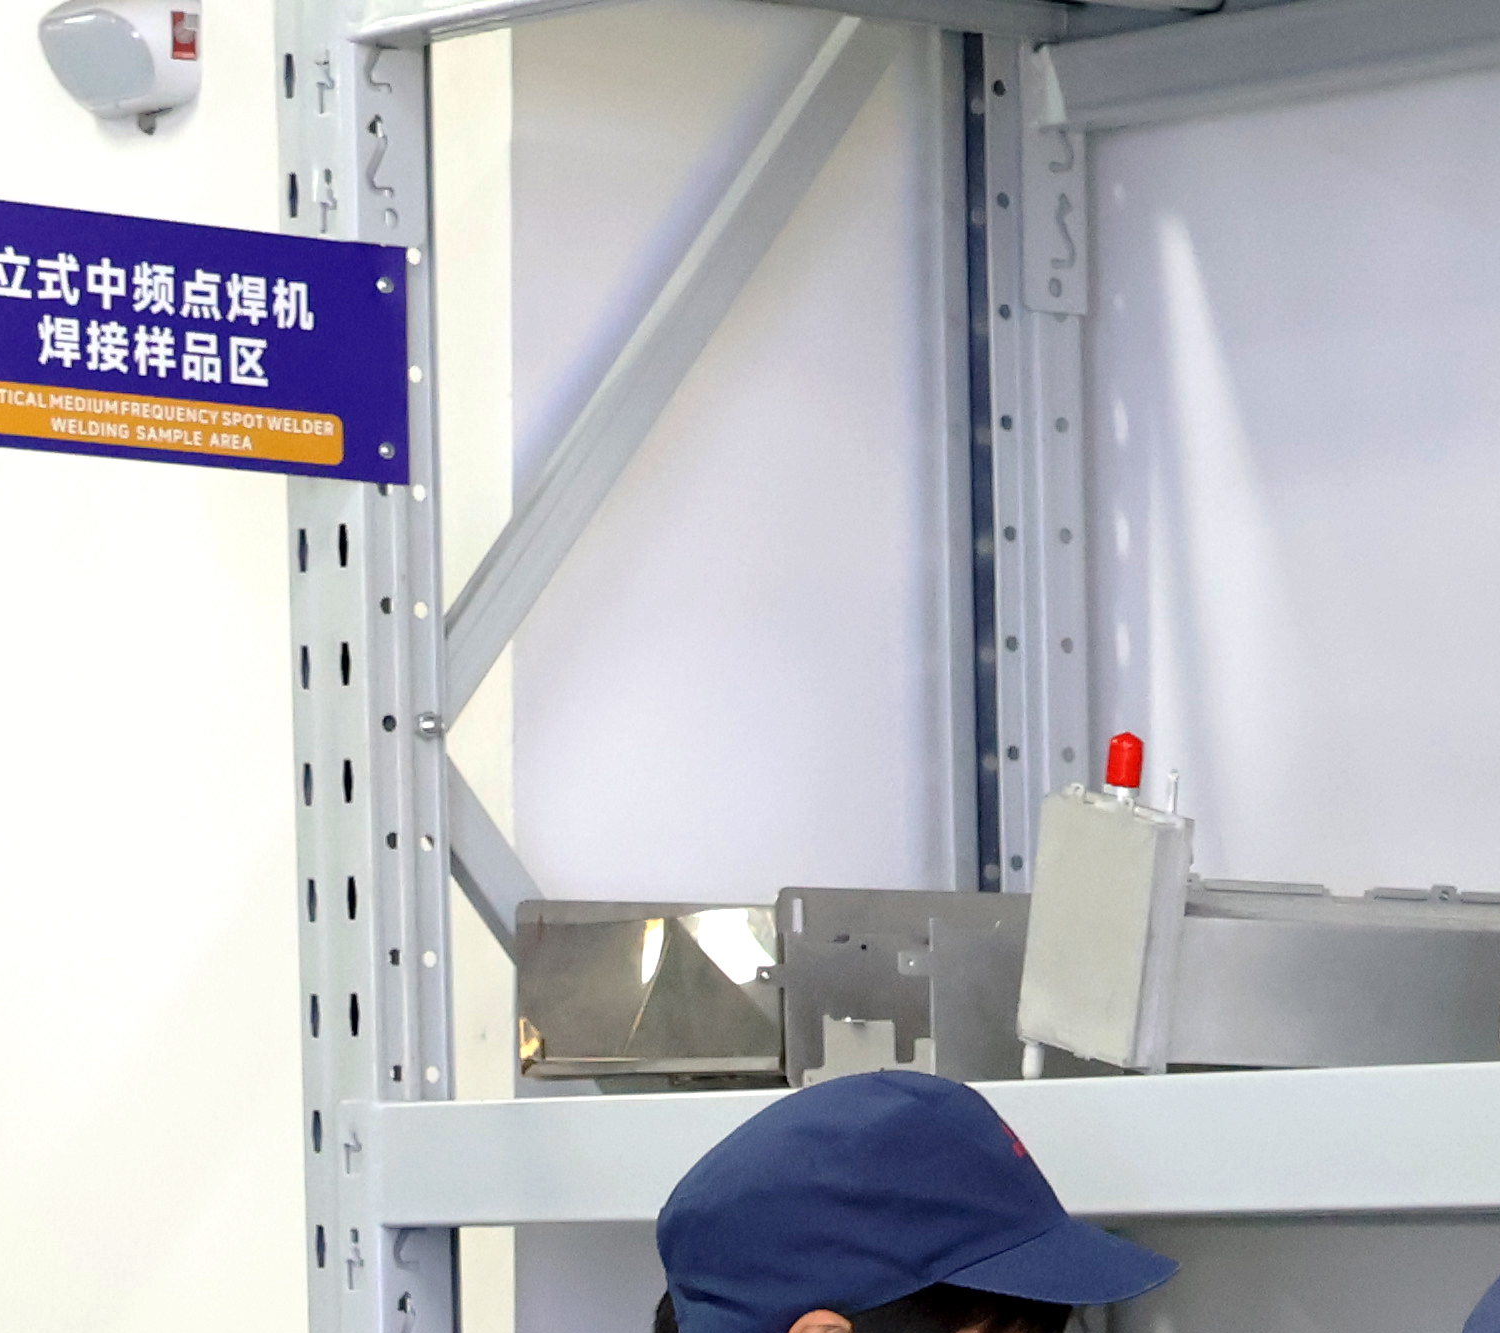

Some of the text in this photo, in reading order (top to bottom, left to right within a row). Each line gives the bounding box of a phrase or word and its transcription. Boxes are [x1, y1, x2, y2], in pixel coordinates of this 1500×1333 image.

[37, 314, 270, 387] 焊接样品区
[49, 393, 118, 416] MEDIUM
[120, 400, 219, 426] FREQUENCY
[221, 410, 264, 430] SPOT
[267, 414, 335, 437] WELDER
[50, 416, 253, 451] WELDING SAMPLE AREA
